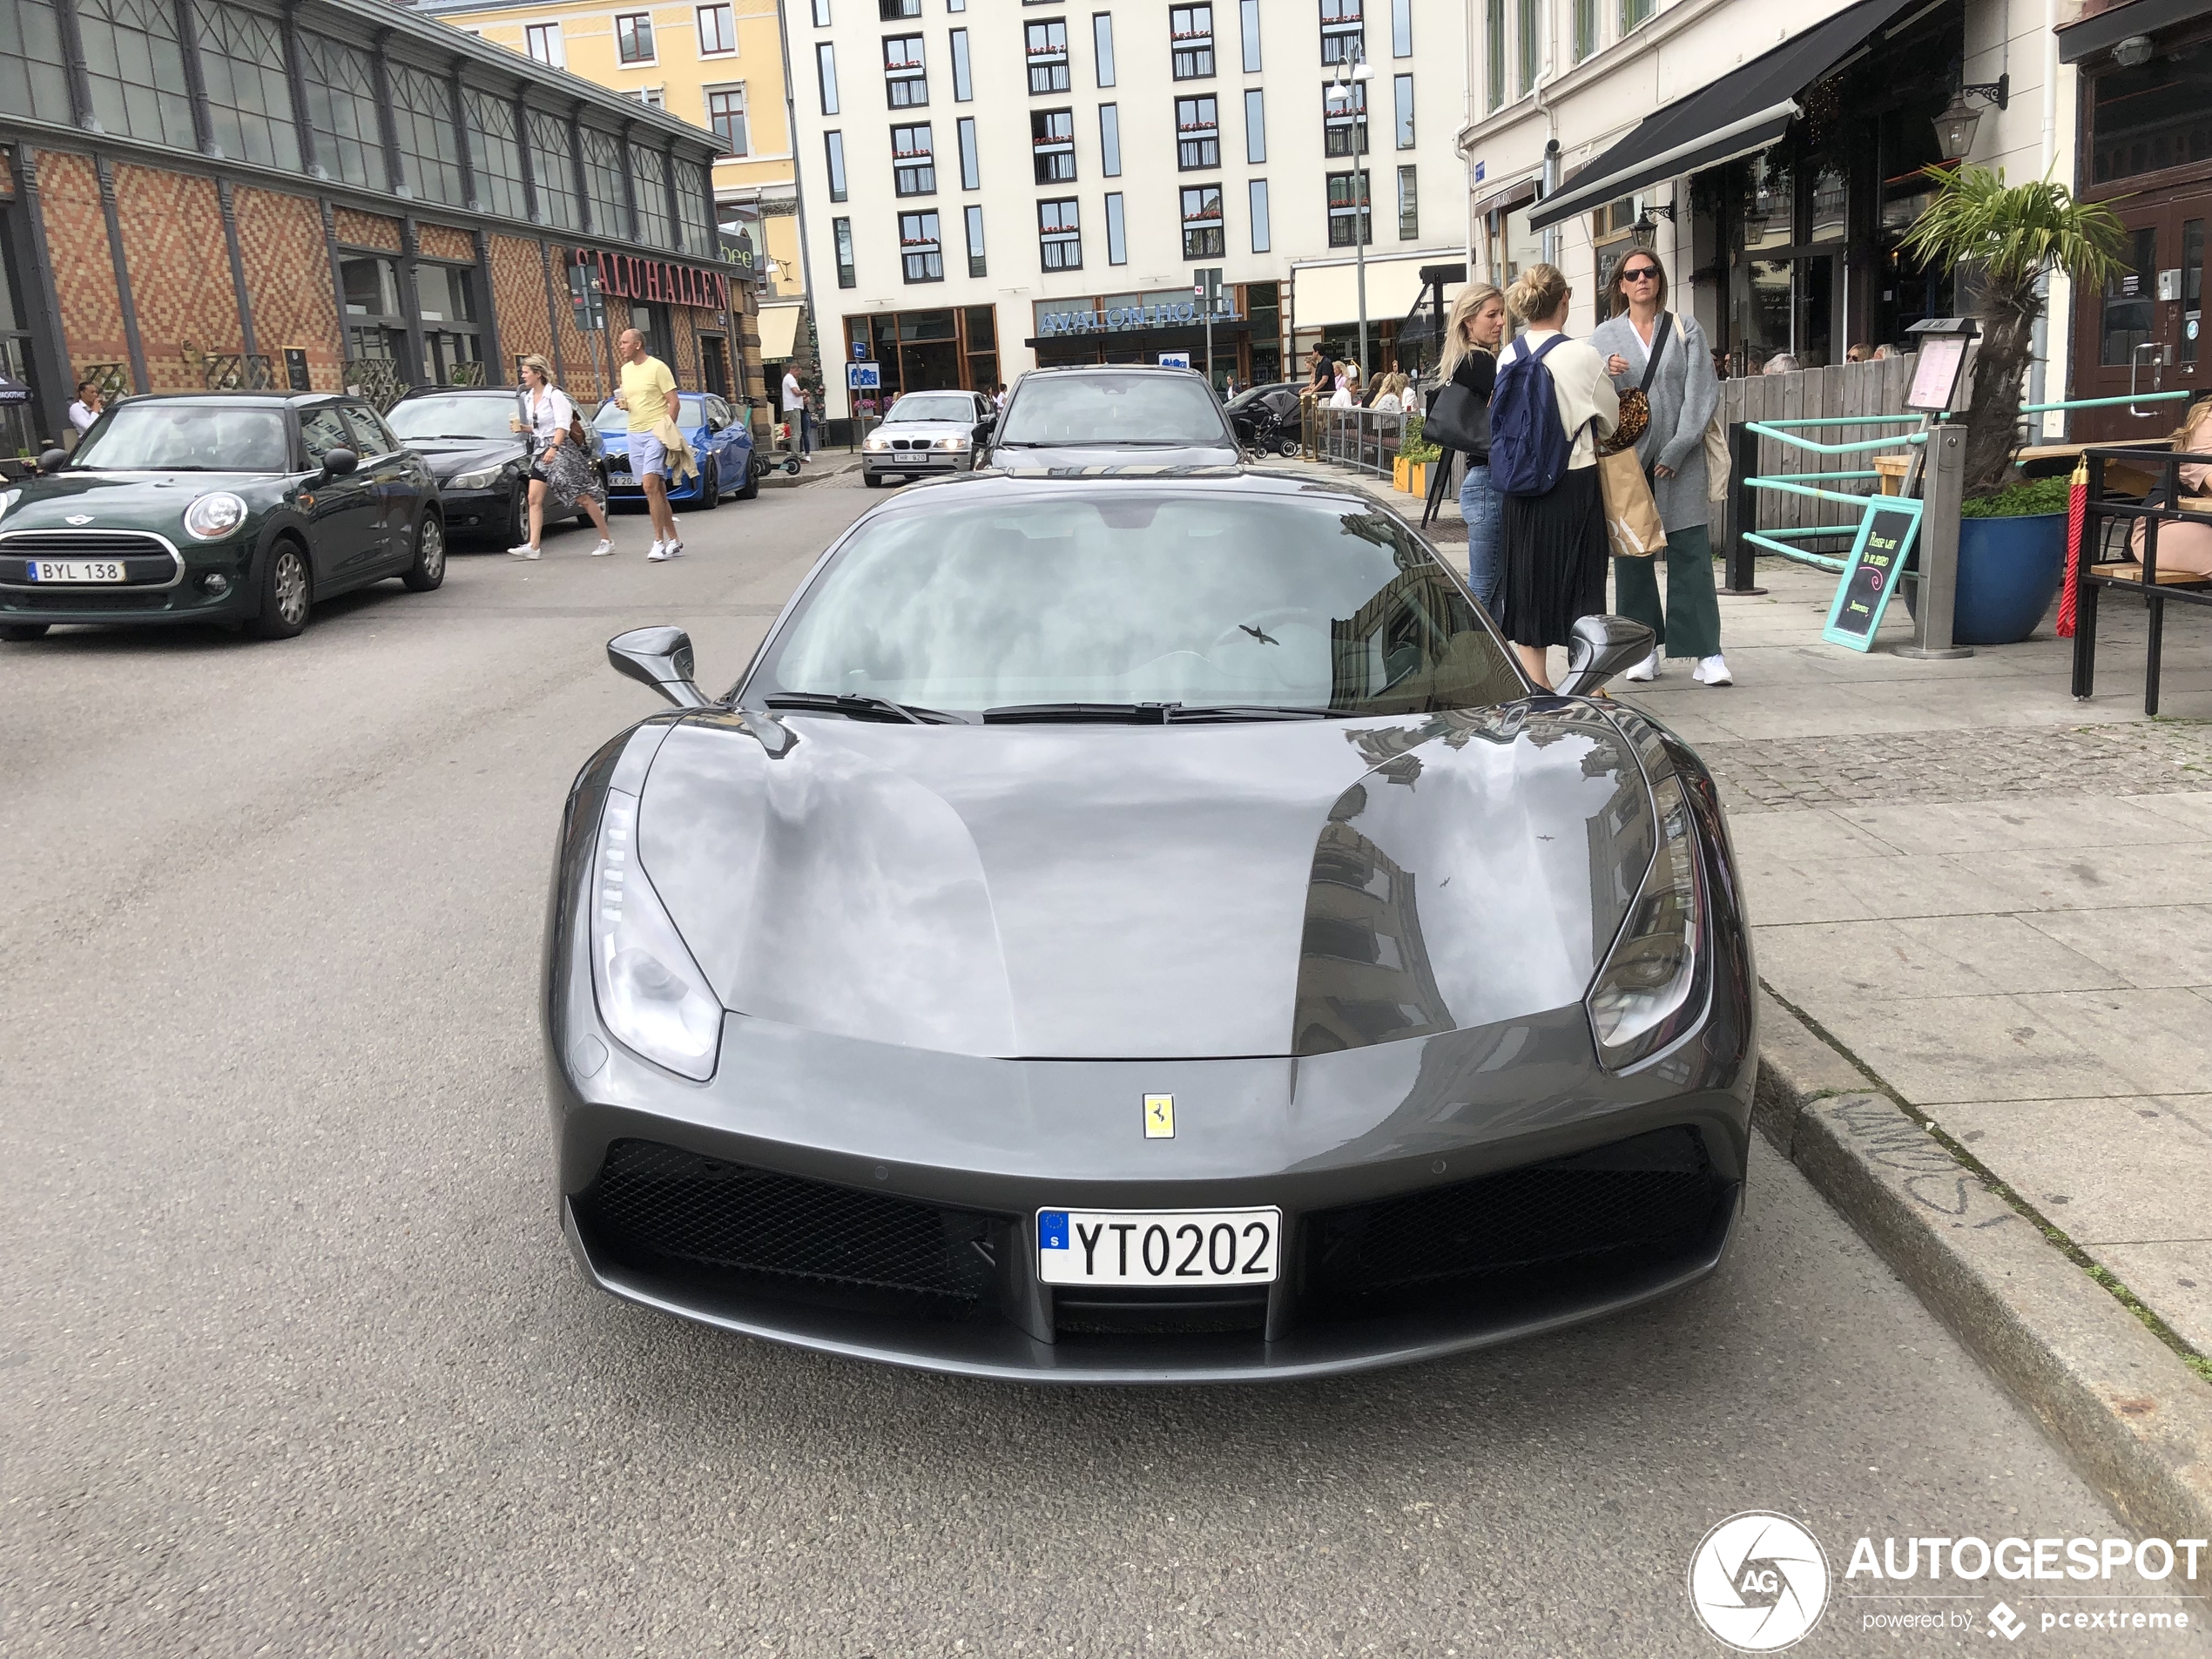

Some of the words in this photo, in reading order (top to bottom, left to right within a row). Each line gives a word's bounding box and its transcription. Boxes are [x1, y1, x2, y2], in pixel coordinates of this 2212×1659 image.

[719, 239, 752, 268] bee
[1039, 306, 1145, 332] AVALON
[1155, 299, 1243, 322] HOL
[43, 563, 78, 579] BYL
[84, 563, 118, 579] 138
[1050, 1236, 1059, 1246] S
